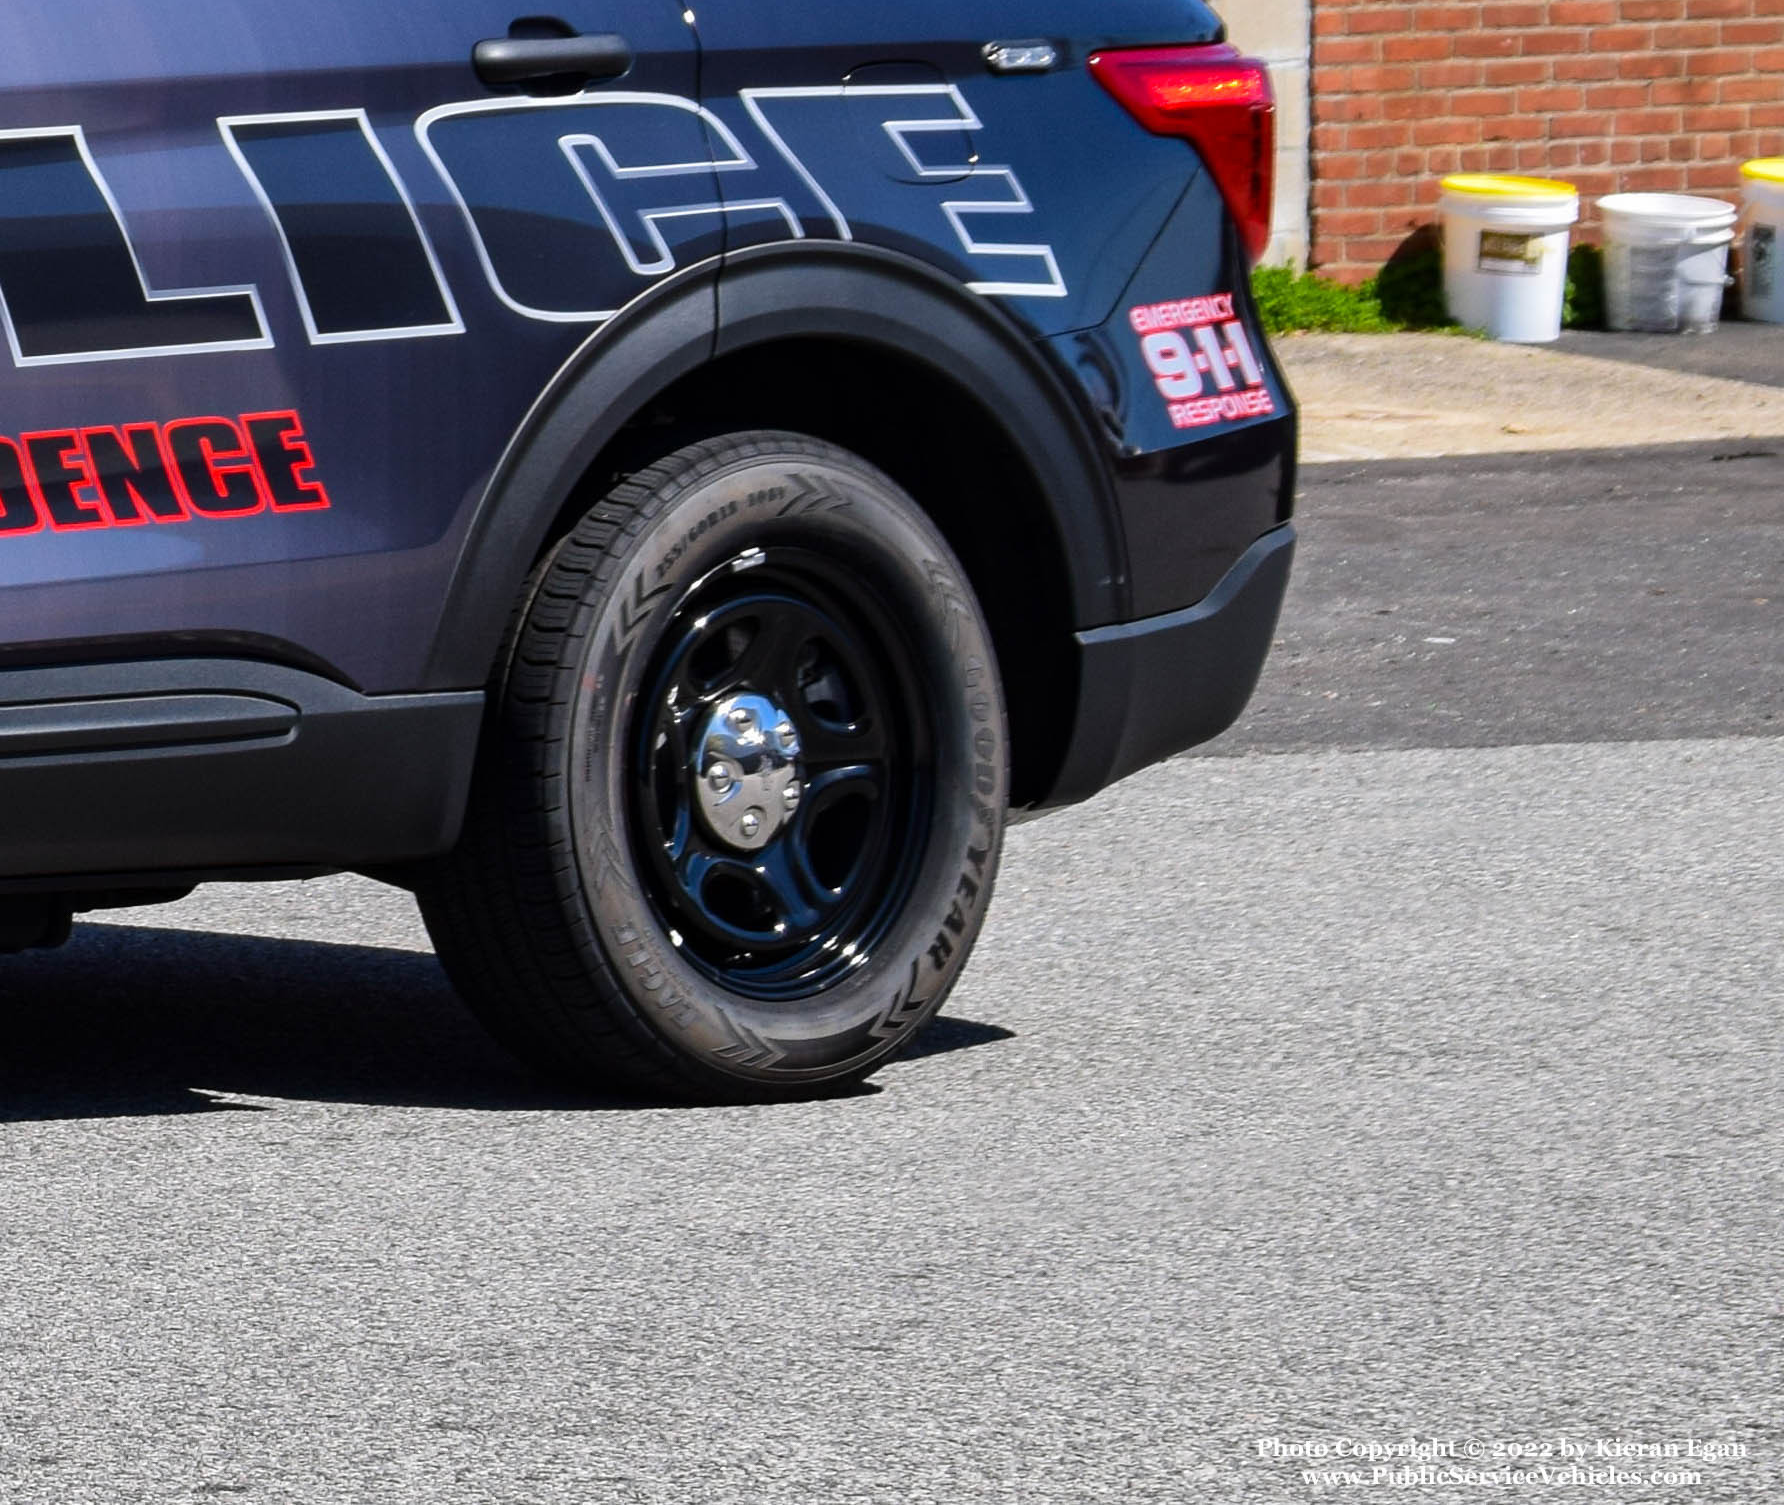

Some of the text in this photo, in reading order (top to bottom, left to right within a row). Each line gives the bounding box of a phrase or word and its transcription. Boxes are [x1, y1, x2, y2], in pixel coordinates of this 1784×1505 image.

[1130, 292, 1235, 335] EMERGENCY
[1167, 388, 1275, 429] RESPONSE
[925, 653, 996, 972] GOODYEAR
